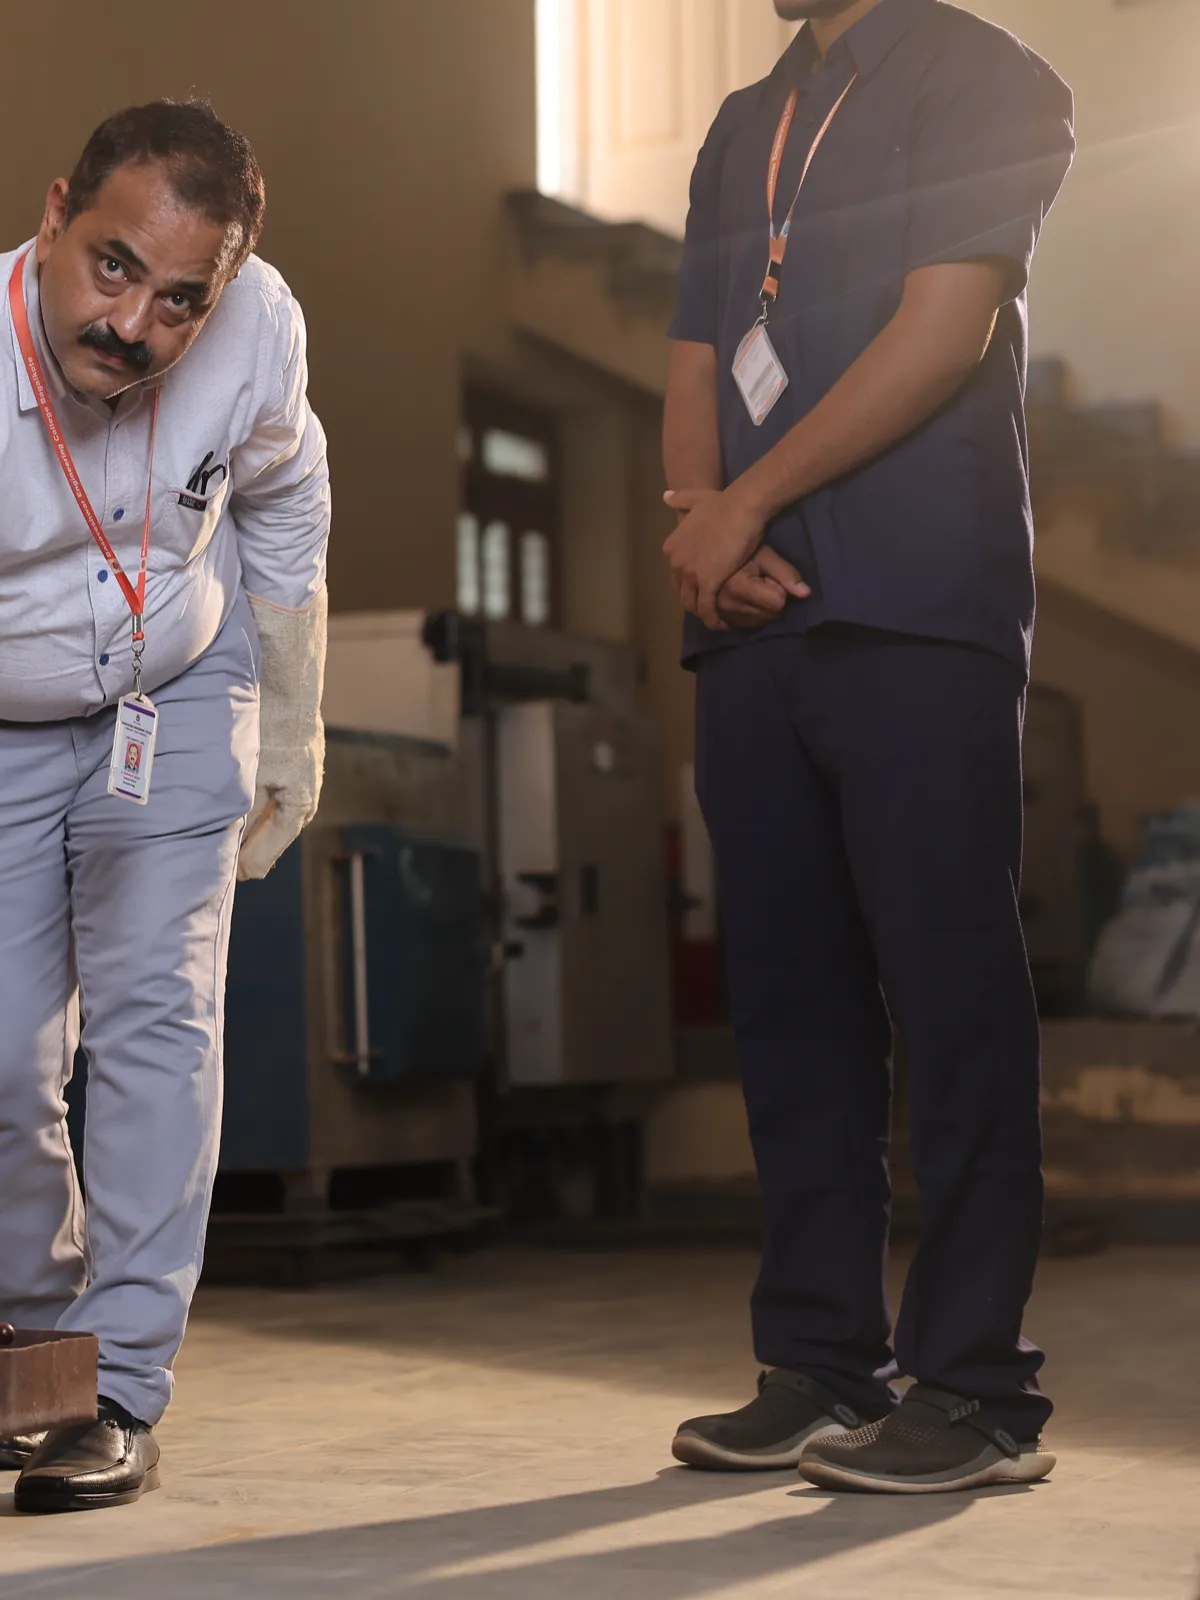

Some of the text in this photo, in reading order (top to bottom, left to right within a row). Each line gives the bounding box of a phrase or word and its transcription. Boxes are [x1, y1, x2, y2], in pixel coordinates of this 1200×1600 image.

[28, 356, 47, 404] Bagalkote
[44, 406, 60, 442] College
[58, 444, 83, 498] Engineering
